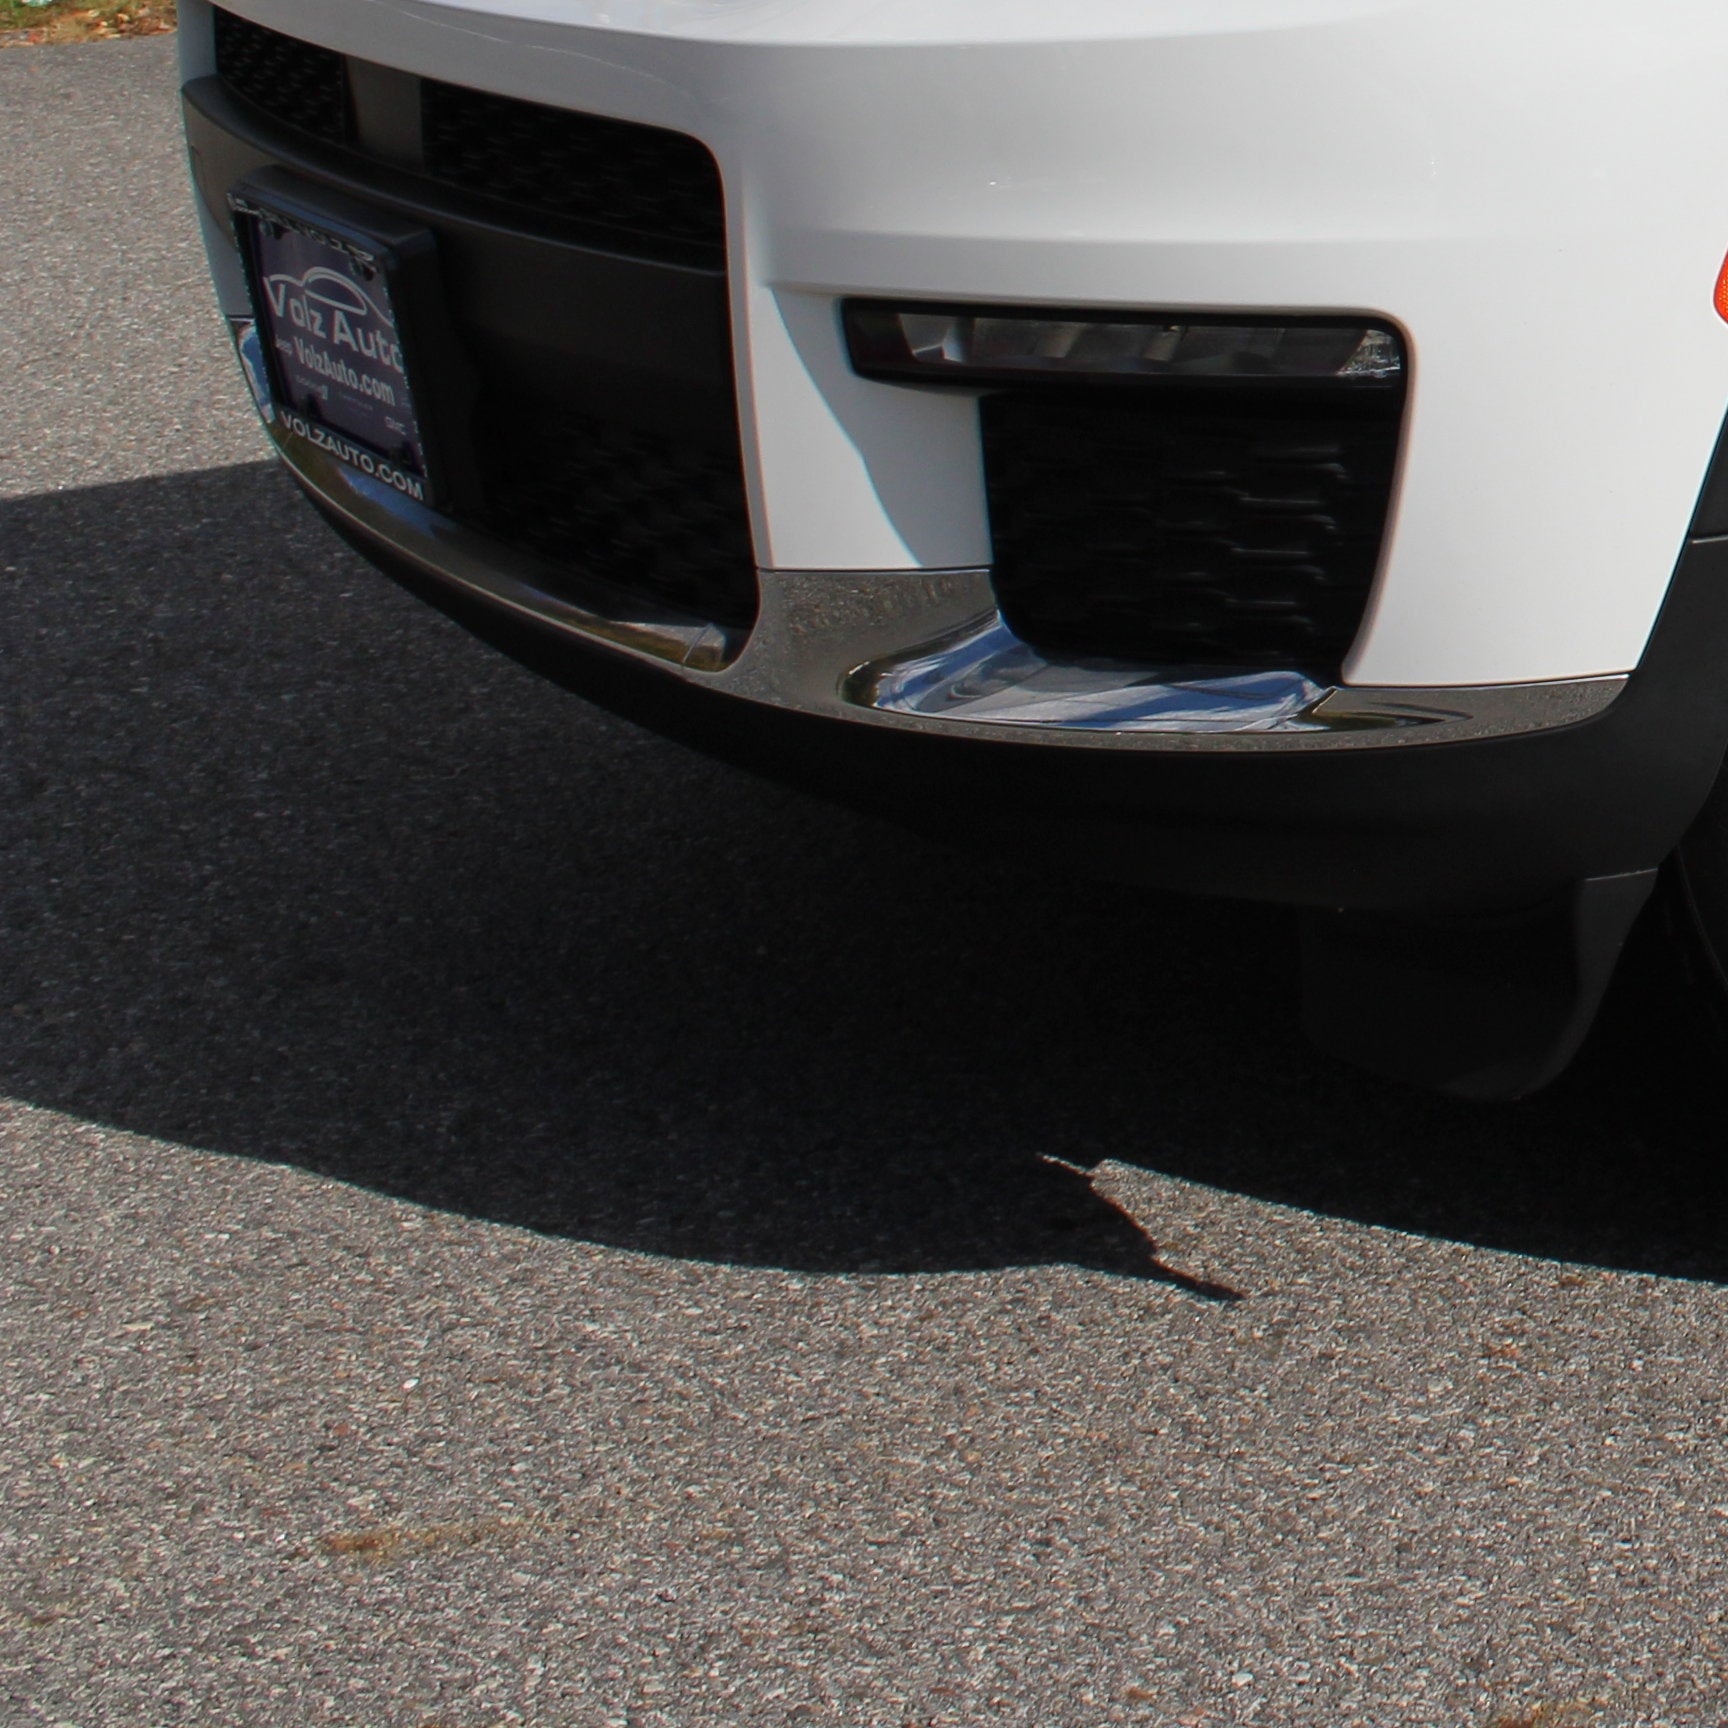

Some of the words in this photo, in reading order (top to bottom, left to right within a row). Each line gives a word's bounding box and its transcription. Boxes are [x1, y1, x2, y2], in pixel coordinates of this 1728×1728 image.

[263, 275, 328, 339] Volz
[294, 336, 396, 406] VolzAuto.com
[280, 410, 424, 501] VOLZAUTO.COM
